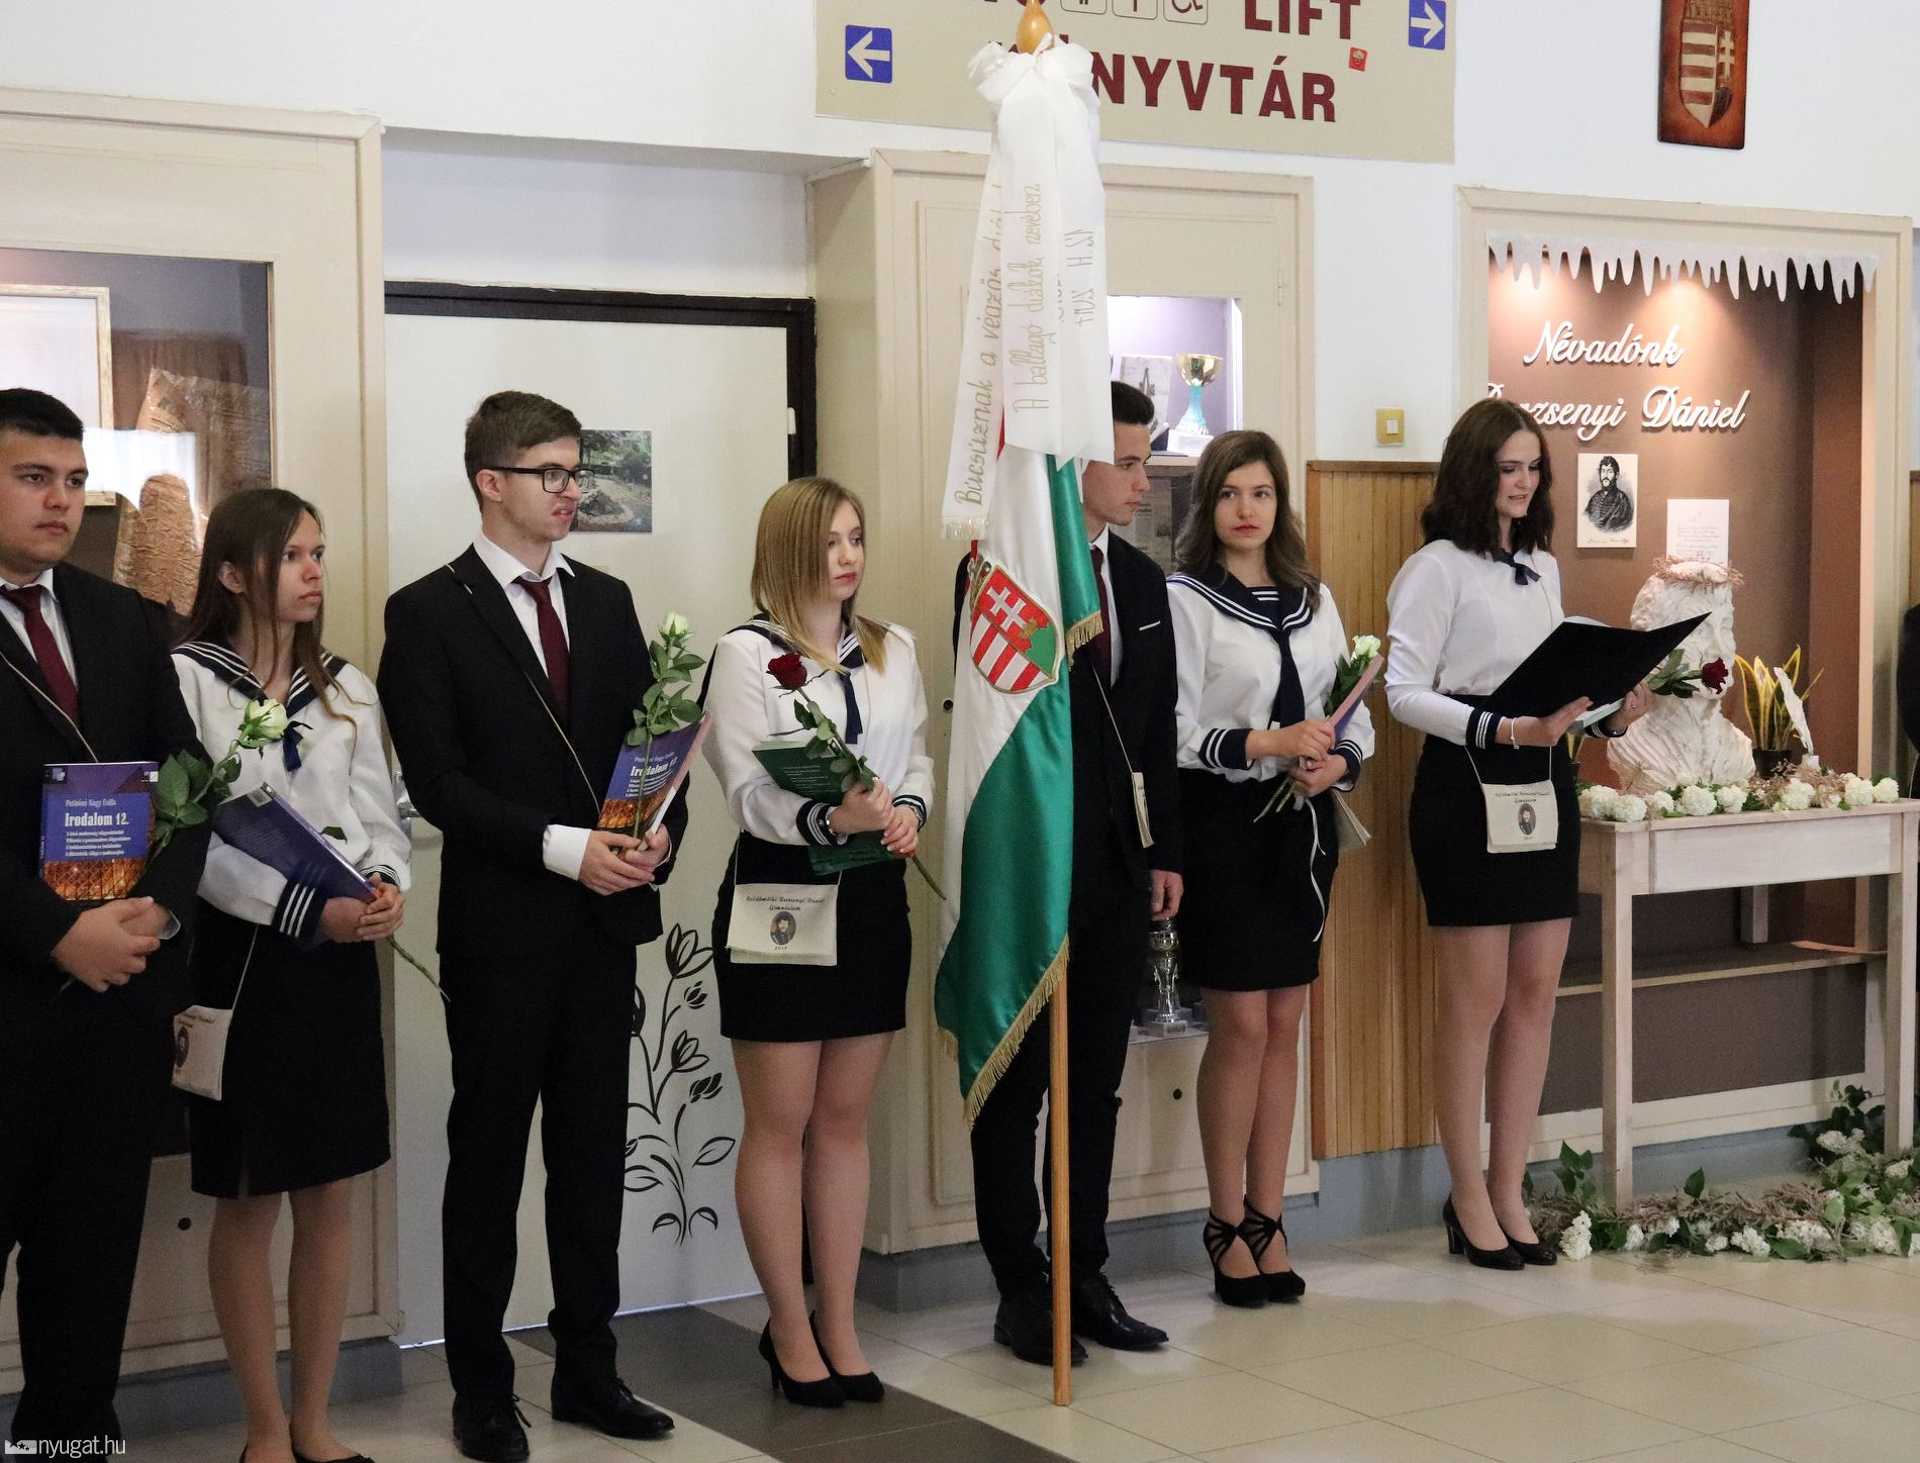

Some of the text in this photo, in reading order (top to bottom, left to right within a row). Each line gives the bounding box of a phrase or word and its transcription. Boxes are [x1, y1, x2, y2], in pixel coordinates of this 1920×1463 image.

[1245, 0, 1361, 40] LIFT
[1008, 34, 1336, 123] NYVTÁR
[980, 351, 999, 368] a
[1522, 320, 1688, 366] Névadónk
[1488, 382, 1751, 442] zsenyi Dániel
[64, 811, 130, 827] Irodalom 12.
